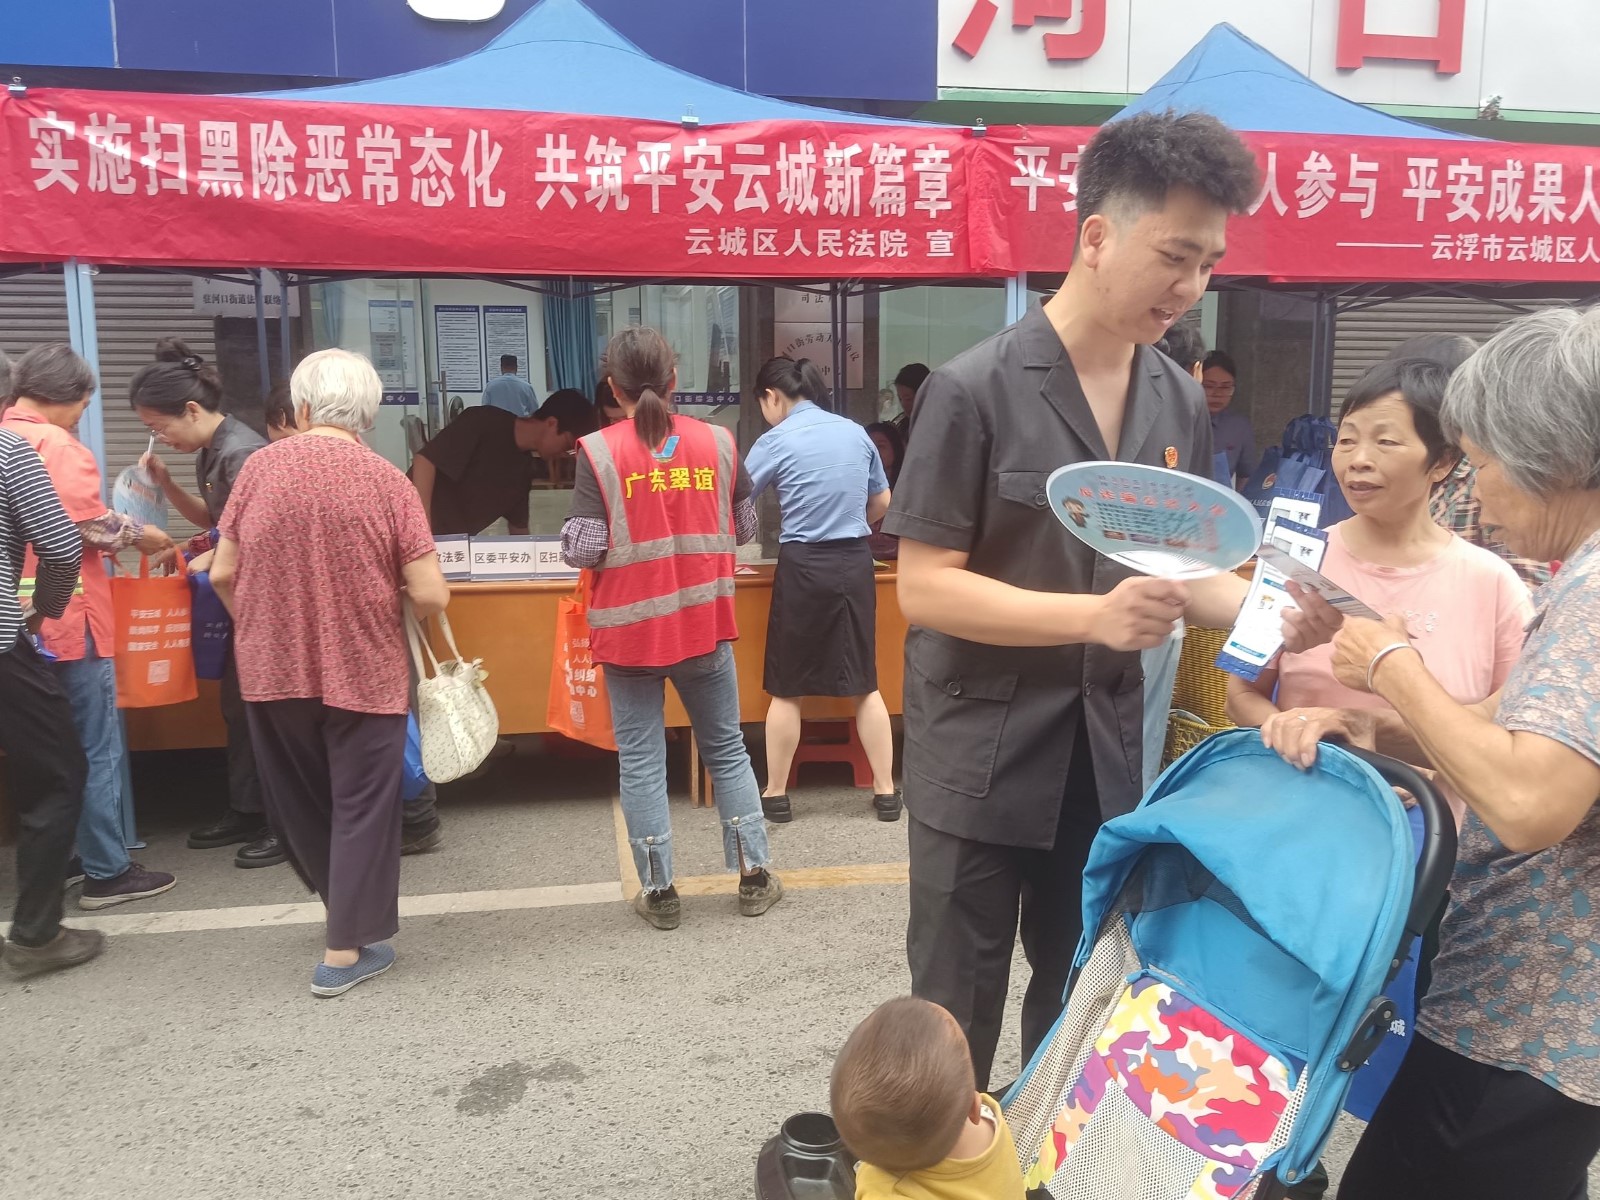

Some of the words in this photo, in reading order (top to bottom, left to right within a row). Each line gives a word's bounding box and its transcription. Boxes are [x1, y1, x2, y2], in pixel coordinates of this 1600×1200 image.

[28, 111, 506, 208] 实施扫黑除恶常态化
[535, 133, 953, 219] 共筑平安云城新篇章
[1248, 150, 1379, 219] 人参与
[1402, 157, 1600, 225] 平安成果人
[685, 227, 909, 258] 云城区人民法院
[926, 230, 955, 257] 宣
[1430, 233, 1600, 263] 云浮市云城区人
[801, 293, 832, 304] 司法
[624, 467, 715, 499] 广东翠谊
[474, 552, 532, 564] 区委平安办
